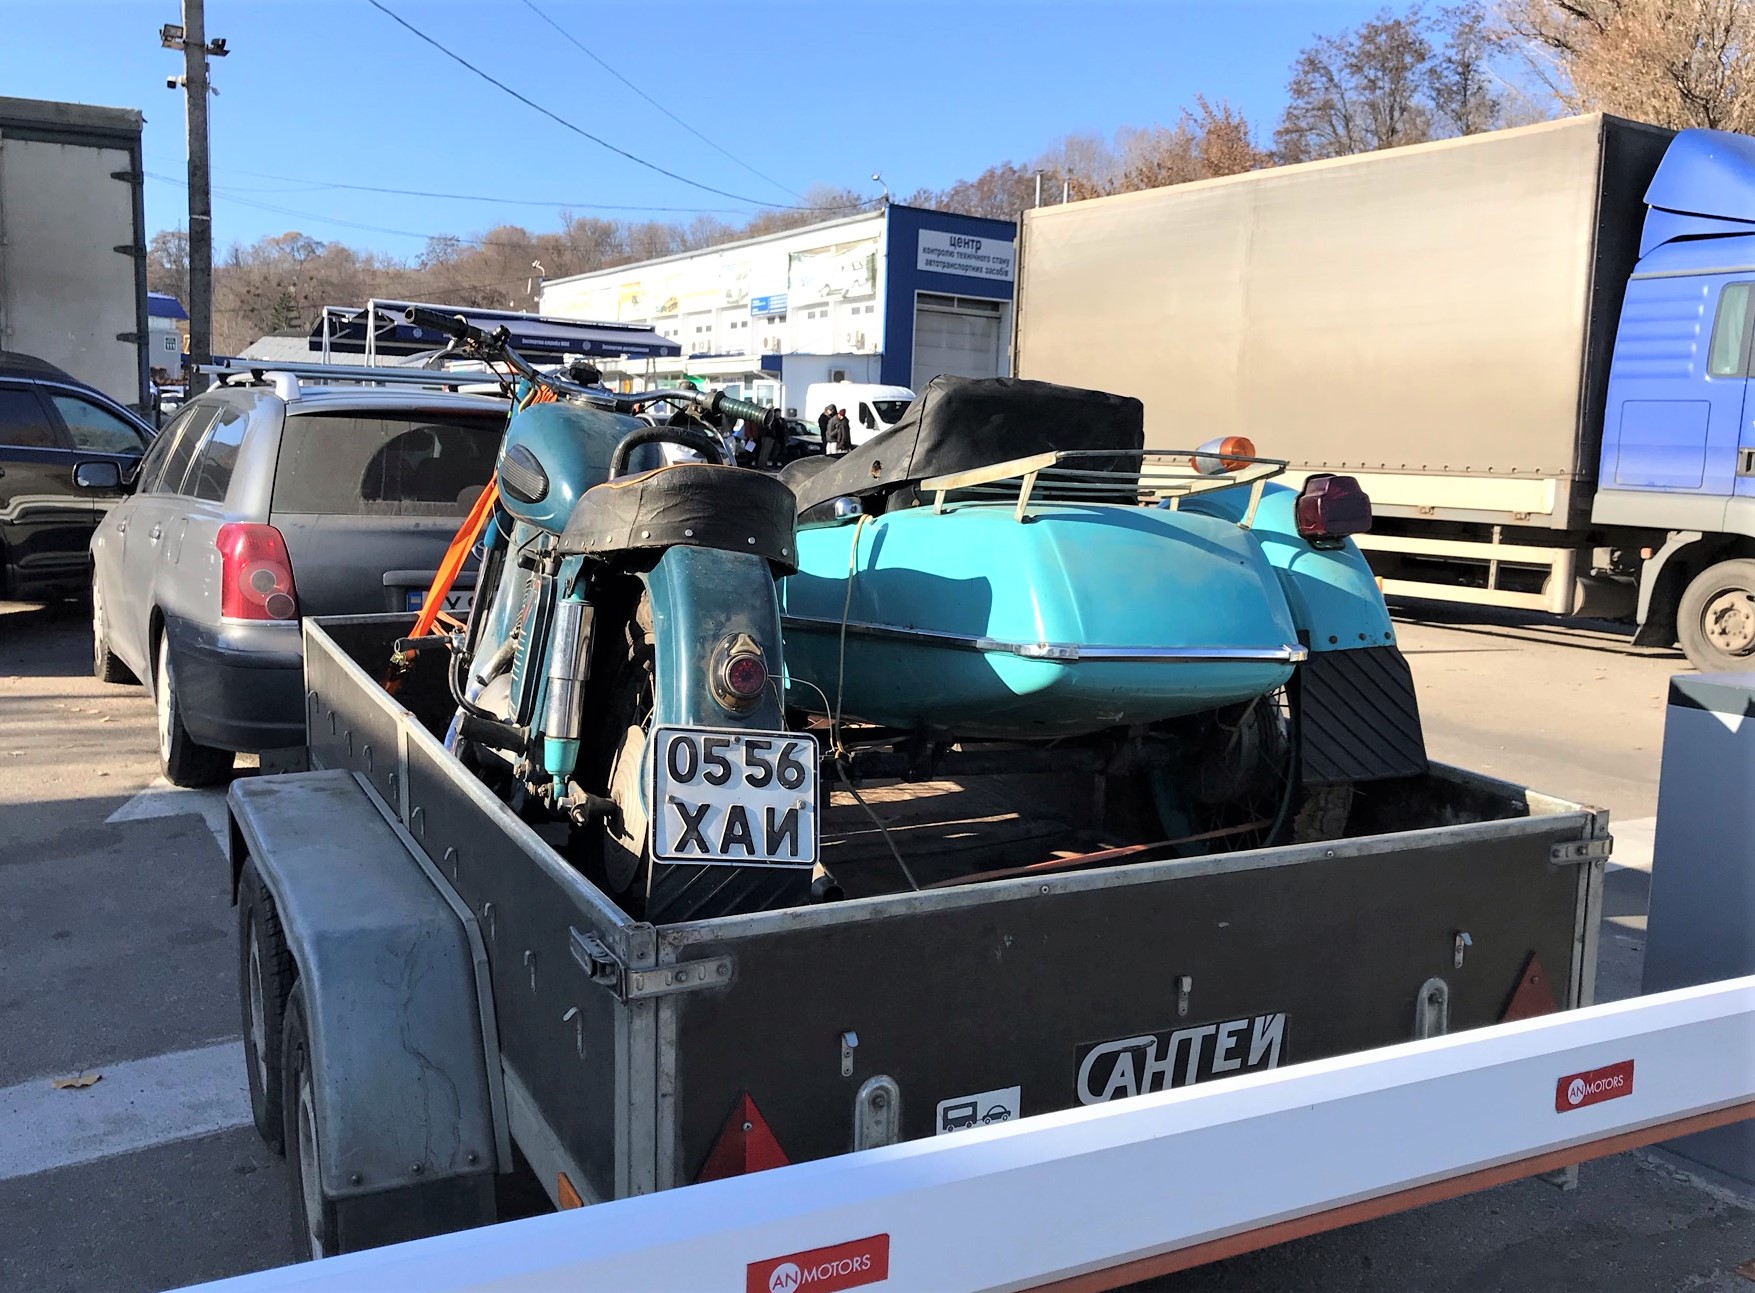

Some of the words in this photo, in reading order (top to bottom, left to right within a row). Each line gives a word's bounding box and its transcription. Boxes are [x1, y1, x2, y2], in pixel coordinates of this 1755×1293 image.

[949, 236, 982, 254] центр
[922, 247, 955, 258] контролю
[956, 251, 991, 263] технічного
[992, 256, 1011, 268] стану
[985, 266, 1009, 277] засобів
[673, 802, 799, 857] ХАИ
